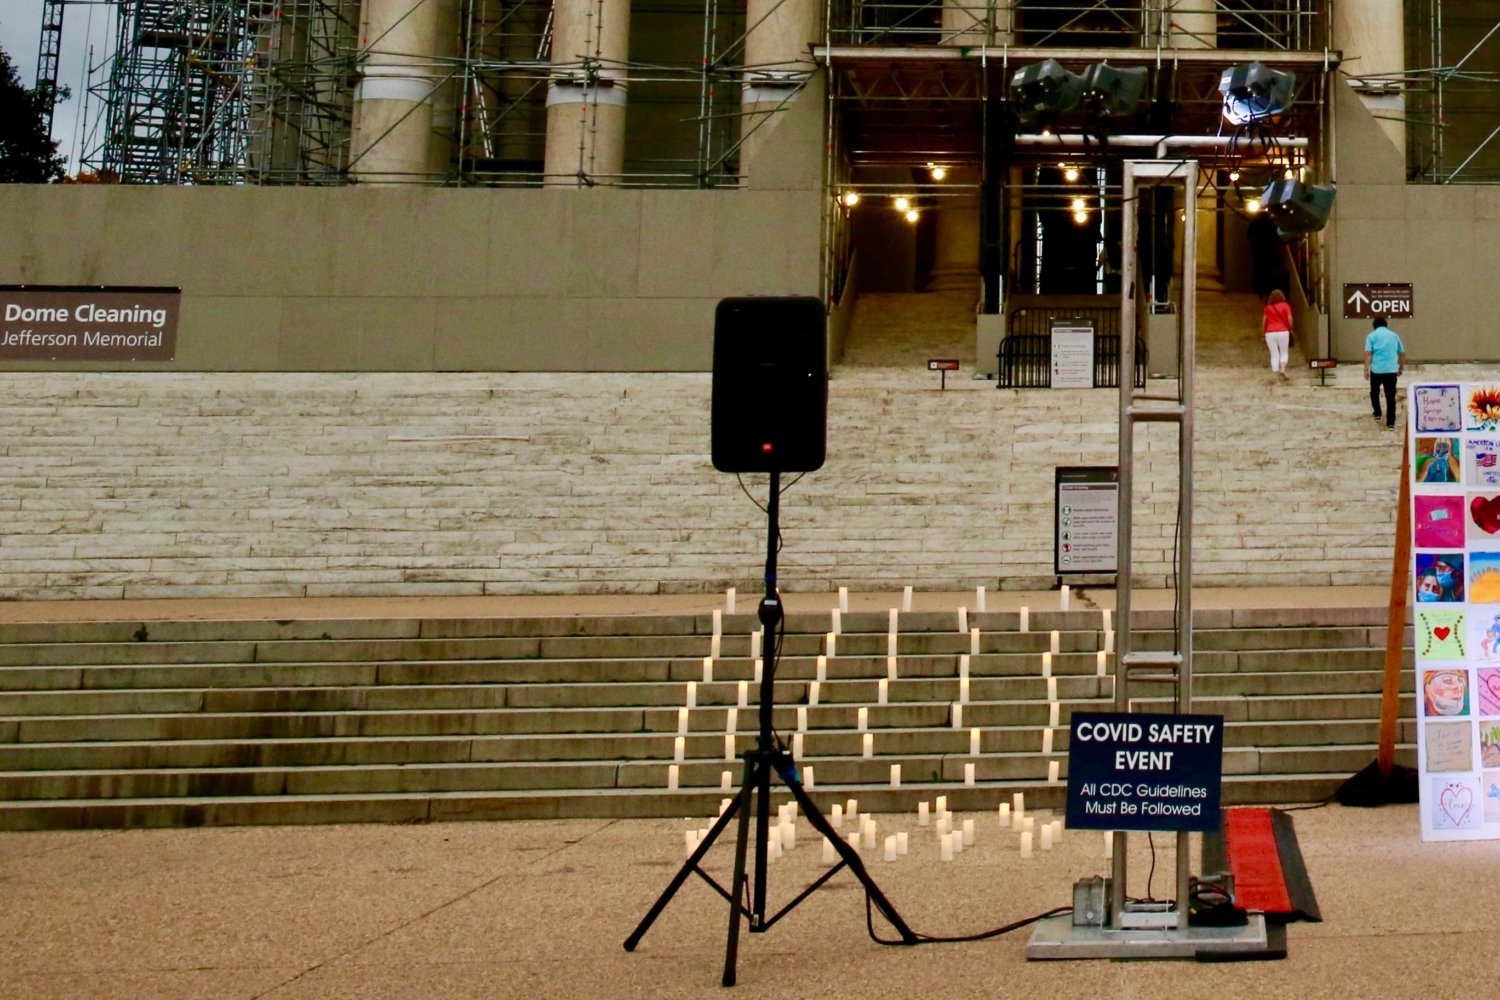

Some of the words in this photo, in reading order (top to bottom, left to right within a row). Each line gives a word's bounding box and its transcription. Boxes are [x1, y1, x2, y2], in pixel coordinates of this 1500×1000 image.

[1371, 300, 1410, 312] OPEN
[5, 304, 69, 322] Dome
[75, 304, 167, 327] Cleaning
[1, 330, 77, 346] Jefferson
[83, 331, 163, 347] Memorial
[1077, 722, 1142, 742] COVID
[1148, 724, 1215, 743] SAFETY
[1115, 751, 1174, 770] EVENT
[1080, 783, 1096, 796] All
[1099, 783, 1133, 797] CDC
[1136, 784, 1207, 798] Guidelines
[1085, 801, 1117, 814] Must
[1120, 802, 1137, 815] Be
[1141, 802, 1201, 816] Followed
